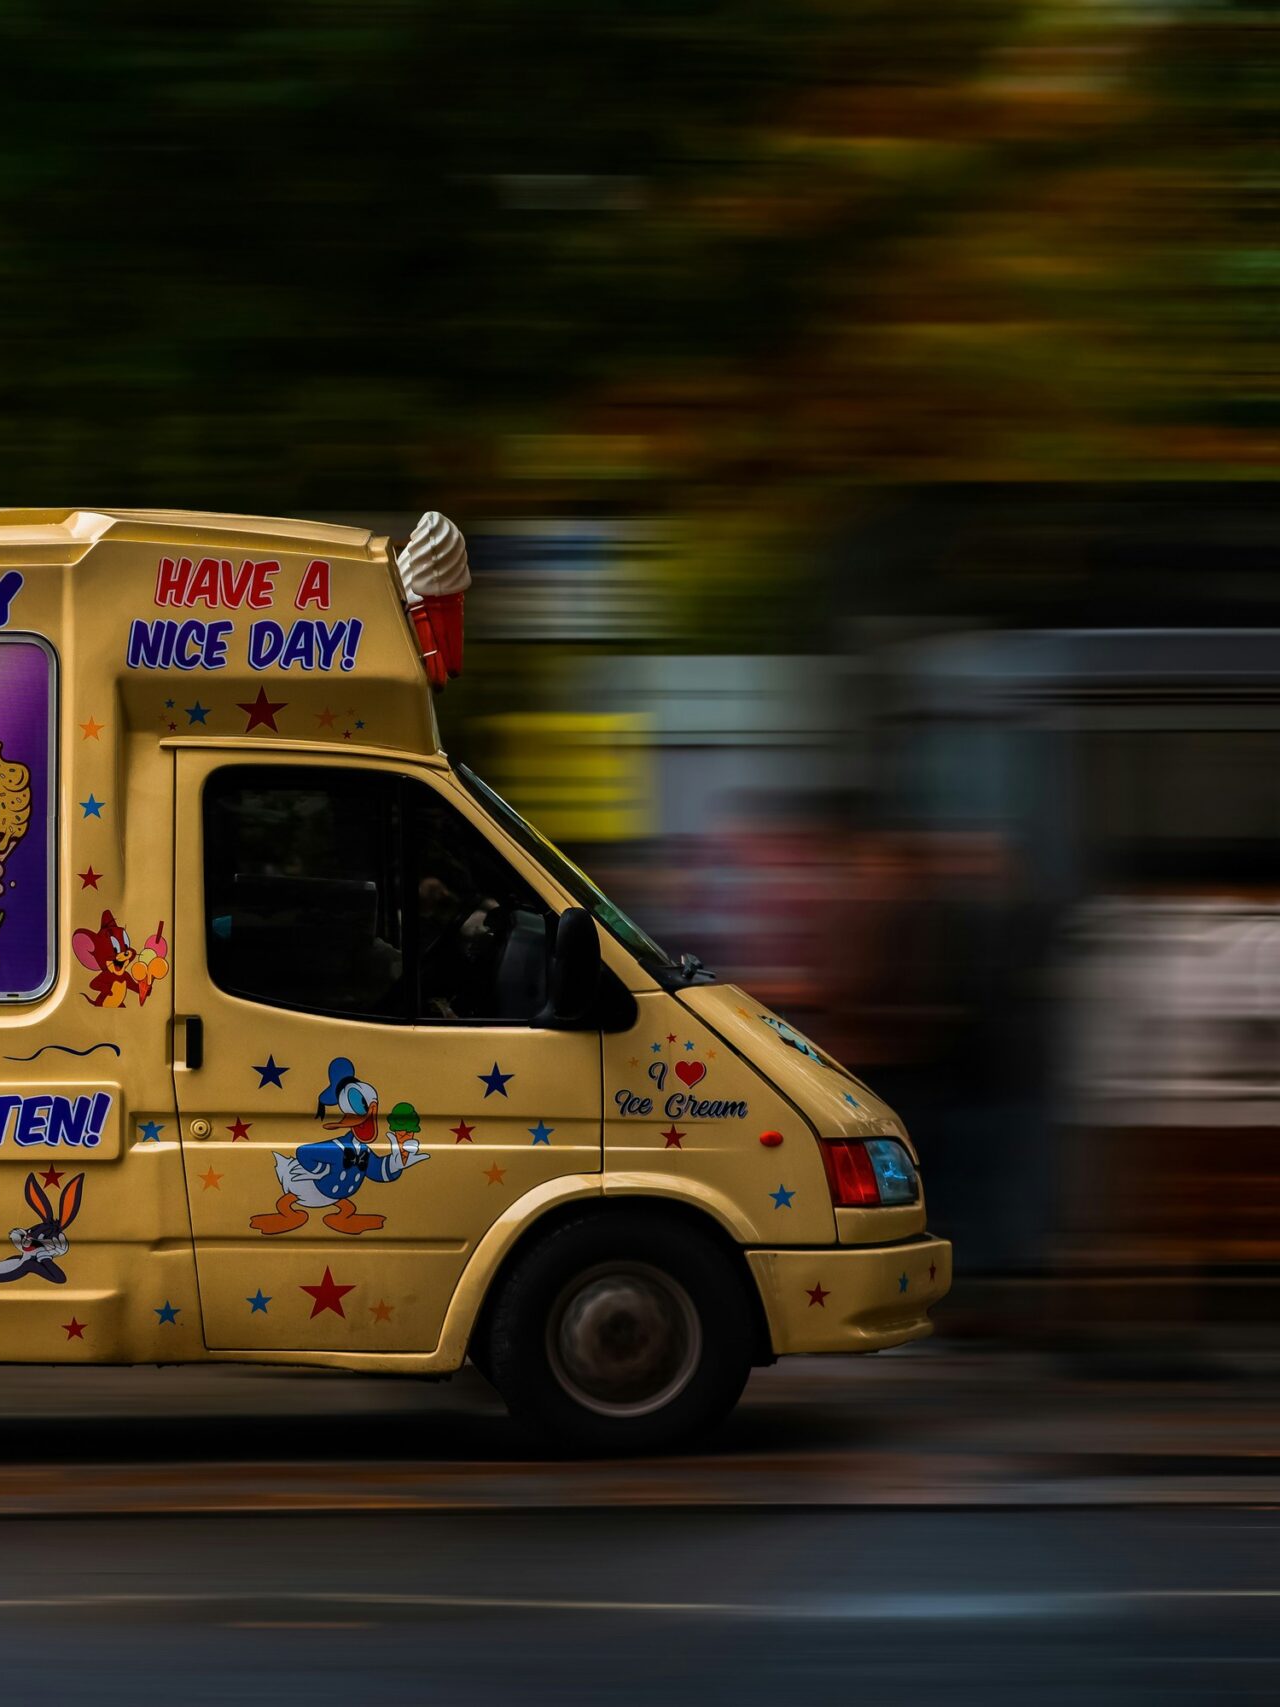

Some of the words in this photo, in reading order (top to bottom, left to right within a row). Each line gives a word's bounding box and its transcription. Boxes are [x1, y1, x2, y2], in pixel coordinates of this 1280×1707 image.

[155, 558, 281, 609] HAVE
[295, 560, 331, 609] A
[128, 619, 233, 669] NICE
[249, 619, 363, 670] DAY!
[649, 1062, 668, 1090] I
[615, 1089, 653, 1117] Ice
[666, 1093, 747, 1119] Cream
